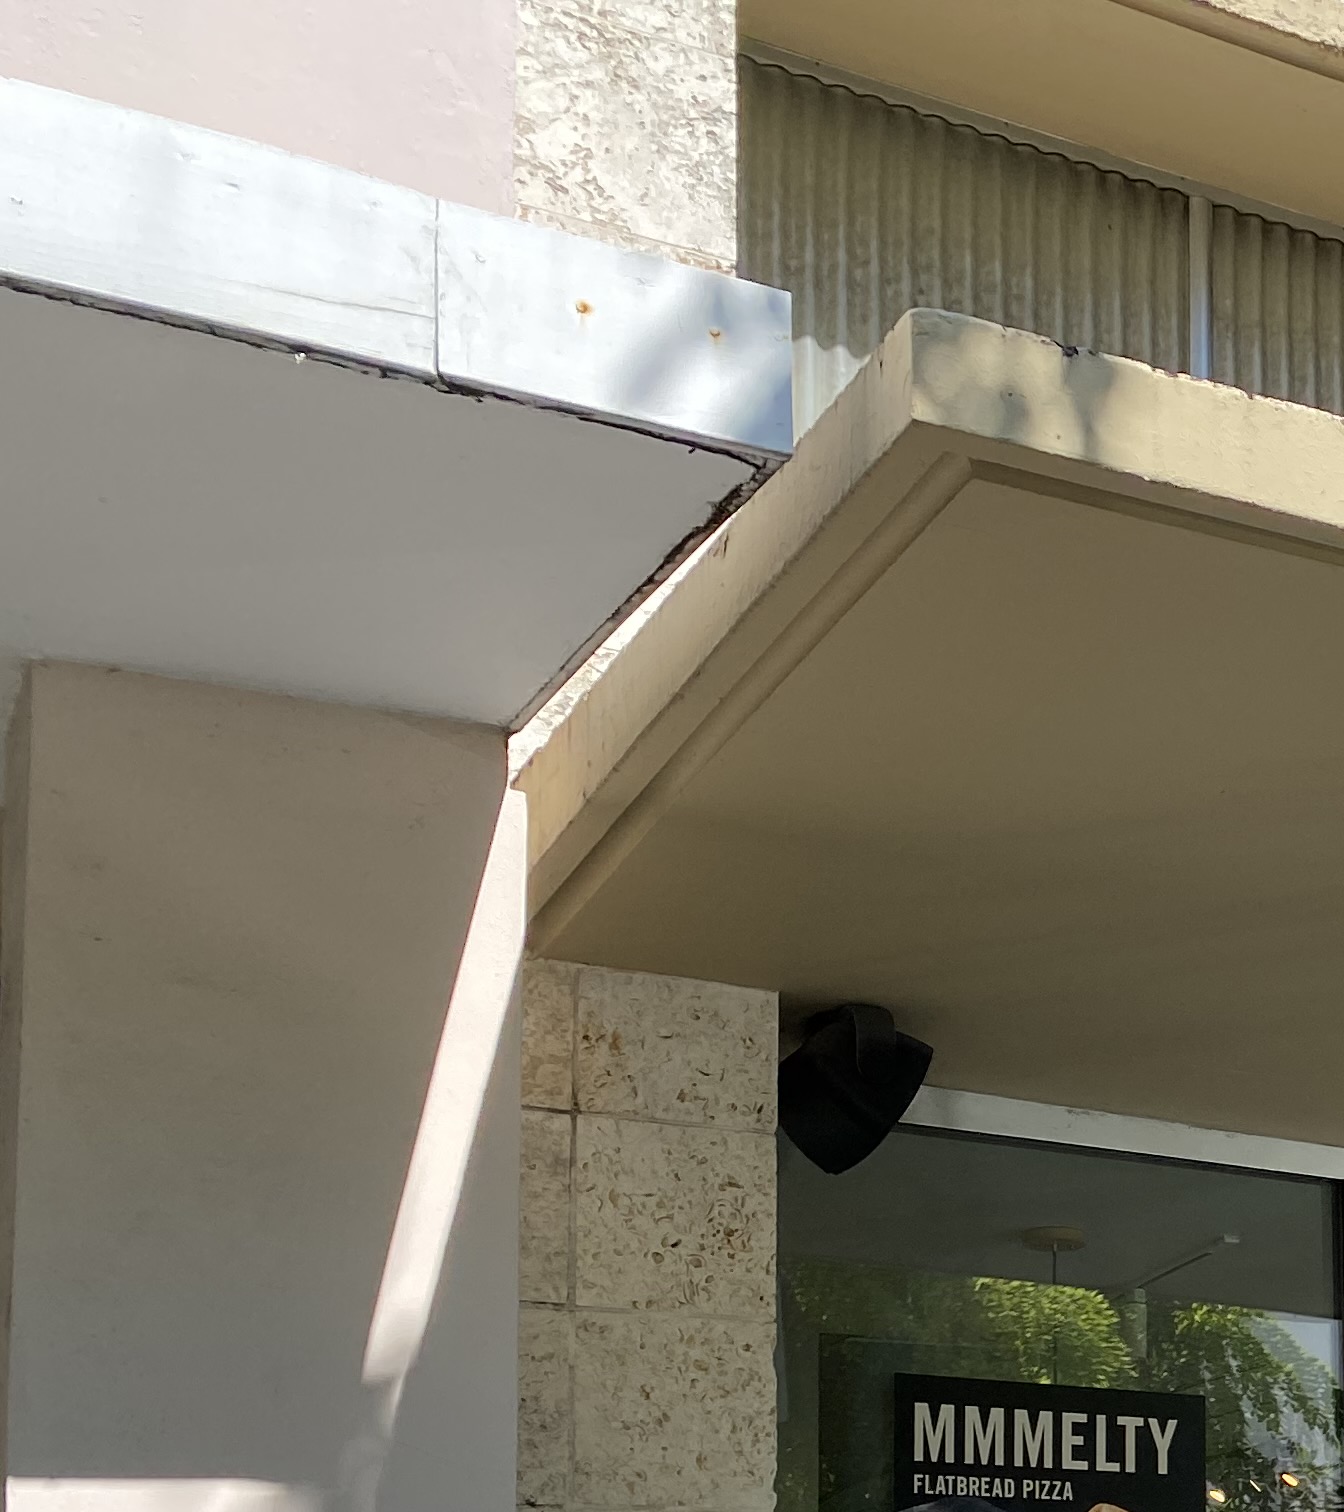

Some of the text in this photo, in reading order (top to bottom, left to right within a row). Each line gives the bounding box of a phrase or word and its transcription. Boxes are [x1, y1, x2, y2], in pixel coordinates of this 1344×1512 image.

[913, 1401, 1179, 1476] MMMELTY
[912, 1473, 1074, 1501] FLATBREAD PIZZA
